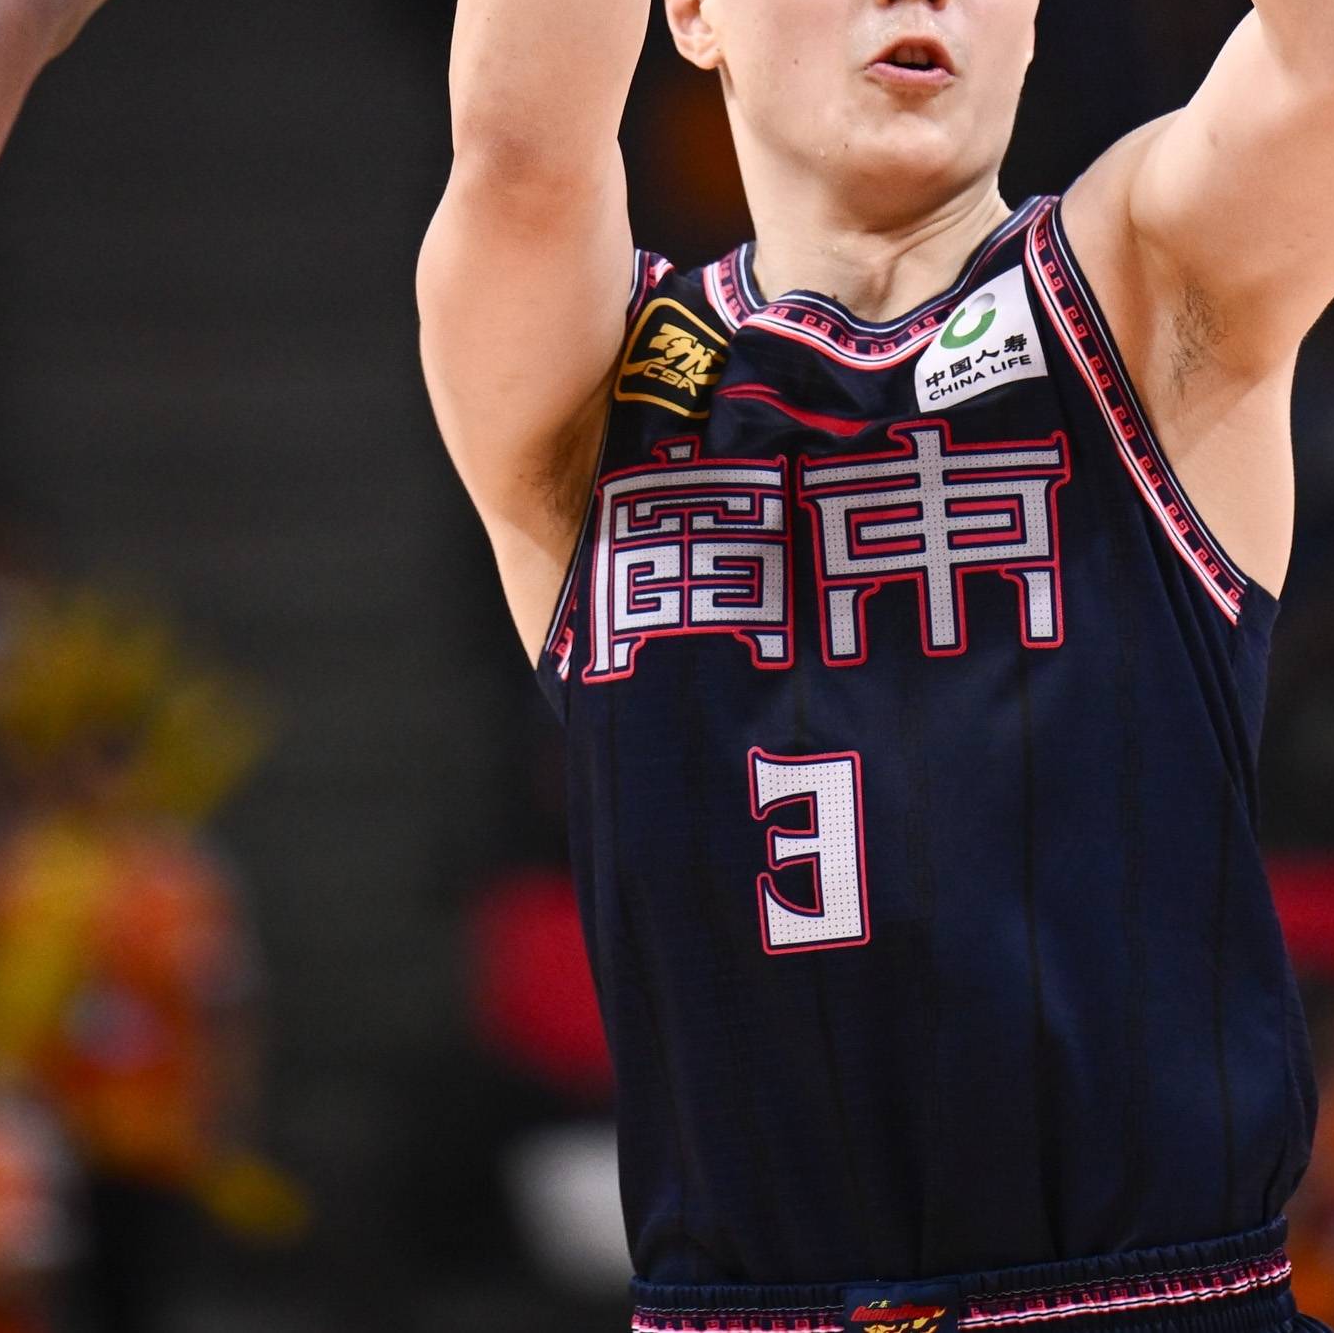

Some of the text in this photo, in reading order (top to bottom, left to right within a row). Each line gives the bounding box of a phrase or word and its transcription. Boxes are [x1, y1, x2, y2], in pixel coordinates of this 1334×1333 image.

[643, 362, 697, 397] CBA
[925, 333, 1028, 389] 中国人寿
[929, 354, 1032, 401] CHINA LIFE
[747, 746, 870, 955] 3
